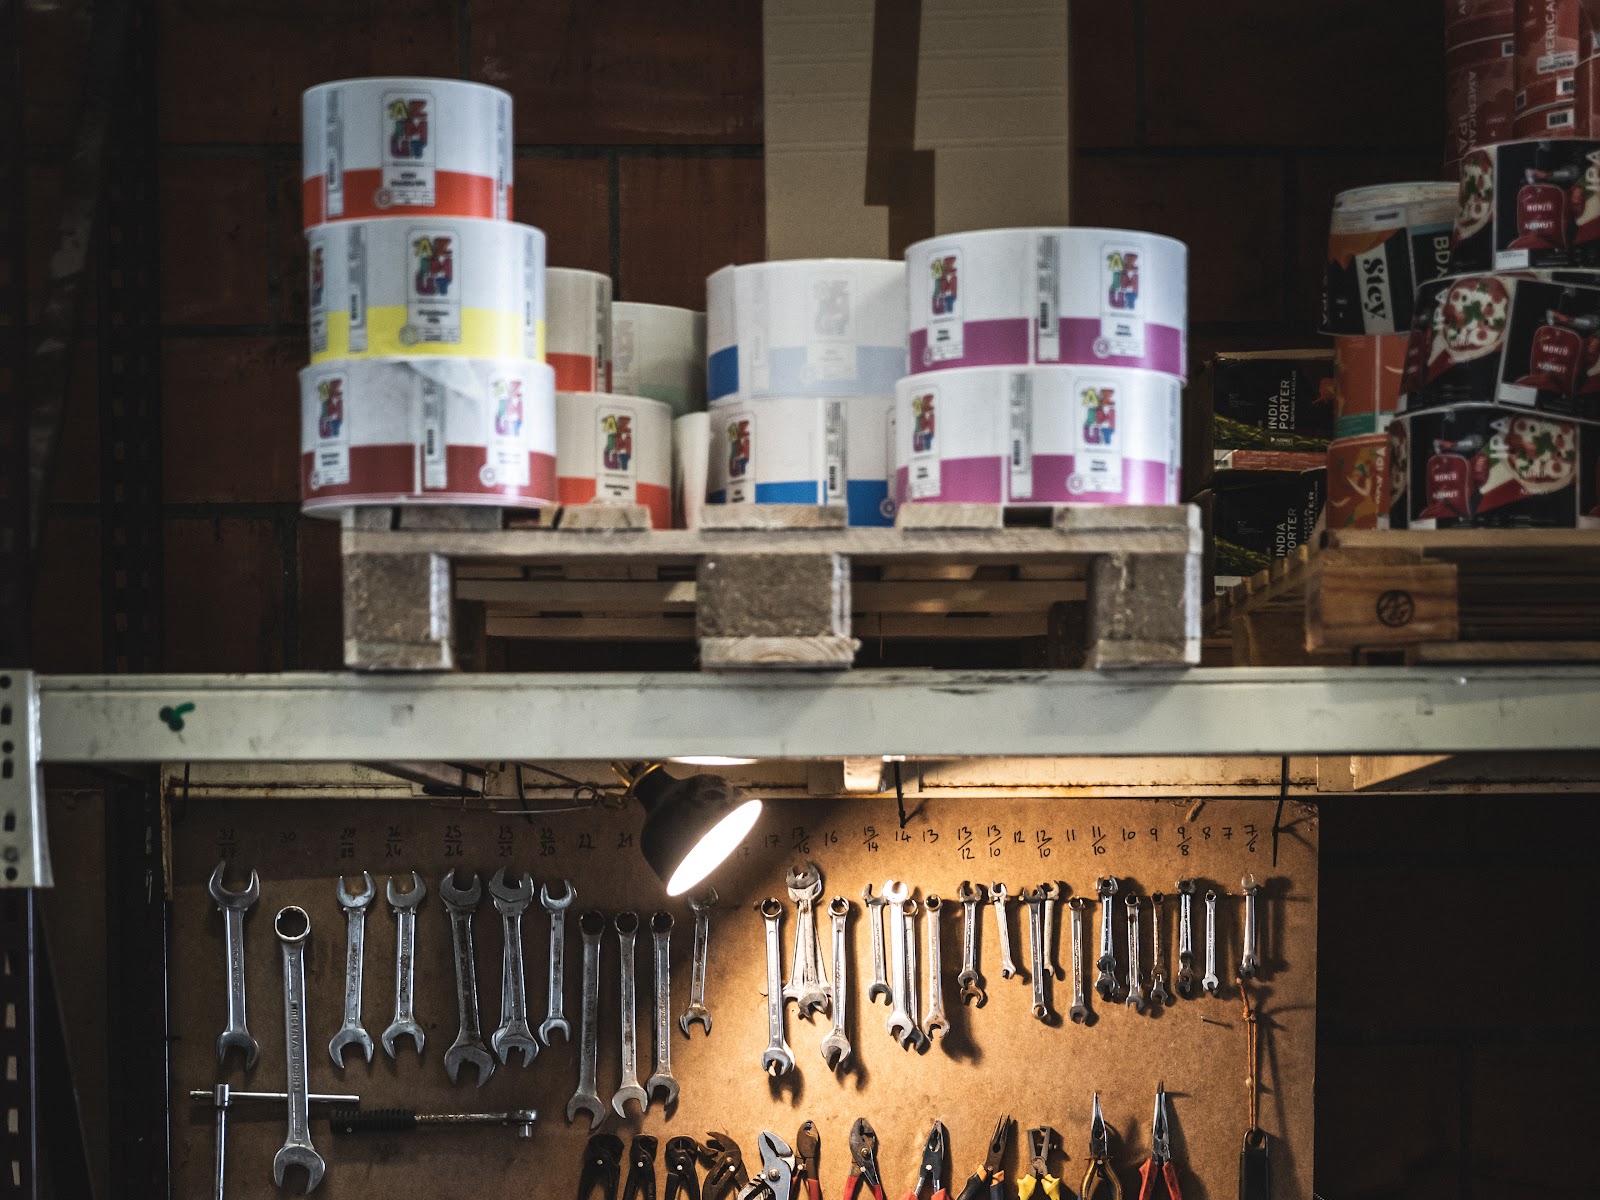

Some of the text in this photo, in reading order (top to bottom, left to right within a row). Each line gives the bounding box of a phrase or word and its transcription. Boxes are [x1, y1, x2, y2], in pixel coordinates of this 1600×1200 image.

[1279, 379, 1290, 430] PORTER
[1268, 395, 1278, 429] INDIA
[1276, 523, 1286, 557] INDIA
[824, 831, 838, 846] 16
[895, 831, 911, 842] 14
[922, 829, 939, 843] 13
[1013, 830, 1025, 843] 12
[1066, 829, 1075, 842] 11
[1122, 828, 1136, 841] 10
[1150, 828, 1158, 841] 9
[1202, 826, 1211, 840] 8
[1222, 827, 1233, 840] 7
[618, 833, 633, 848] 21
[764, 835, 780, 848] 17
[290, 1001, 301, 1091] CHROME VANADIUM
